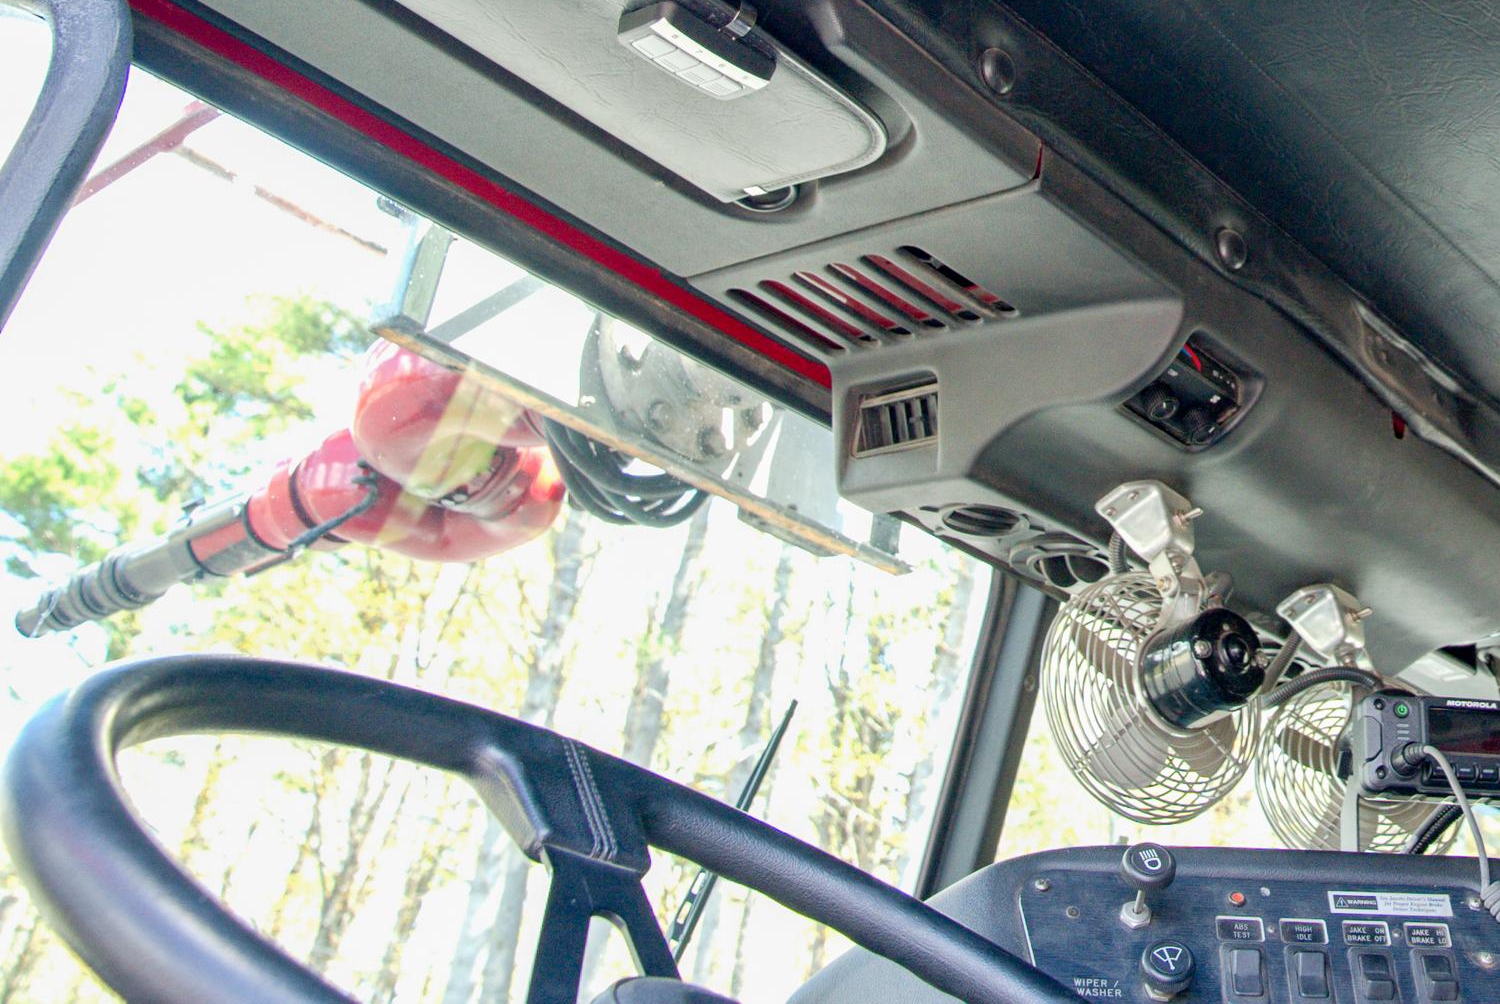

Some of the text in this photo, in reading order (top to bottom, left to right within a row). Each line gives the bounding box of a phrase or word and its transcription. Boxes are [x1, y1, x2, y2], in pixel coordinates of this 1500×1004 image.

[1446, 699, 1497, 709] MOTOROLA
[1073, 978, 1119, 988] WIPER /
[1076, 988, 1122, 997] WASHER
